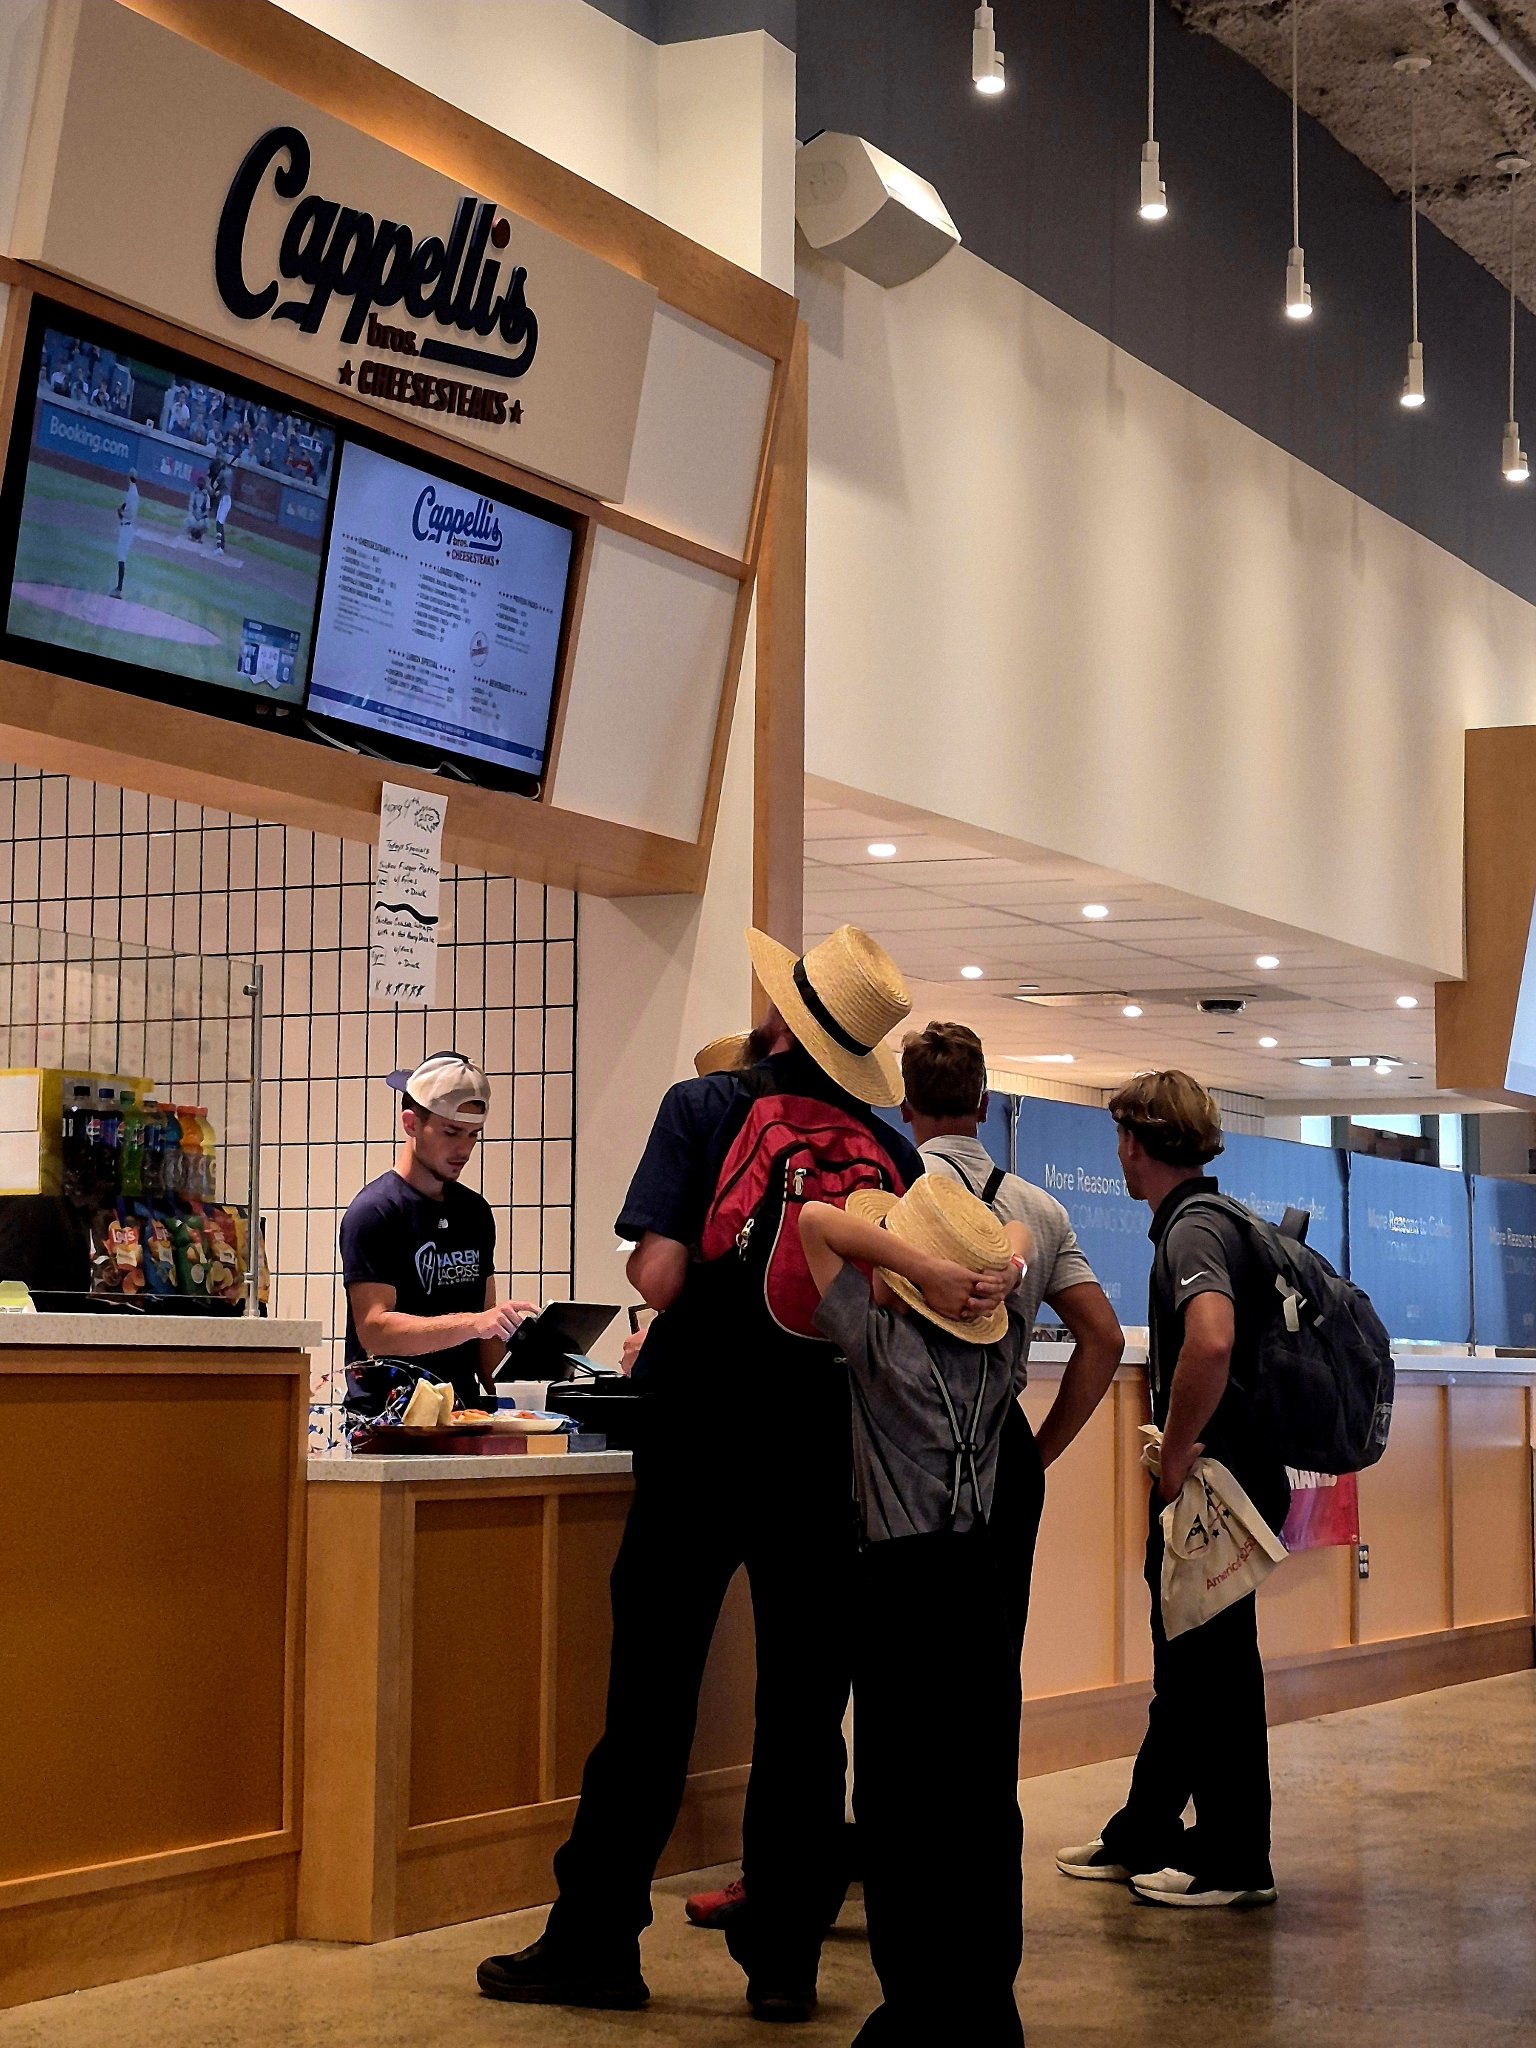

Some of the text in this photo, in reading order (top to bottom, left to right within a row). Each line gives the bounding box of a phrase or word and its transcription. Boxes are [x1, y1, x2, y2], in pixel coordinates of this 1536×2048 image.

[357, 360, 510, 424] CHEESESTEAKS
[50, 415, 129, 459] Booking.com
[452, 549, 495, 567] CHEESESTEAKS
[1044, 1163, 1075, 1191] More
[1077, 1166, 1121, 1197] Reasons
